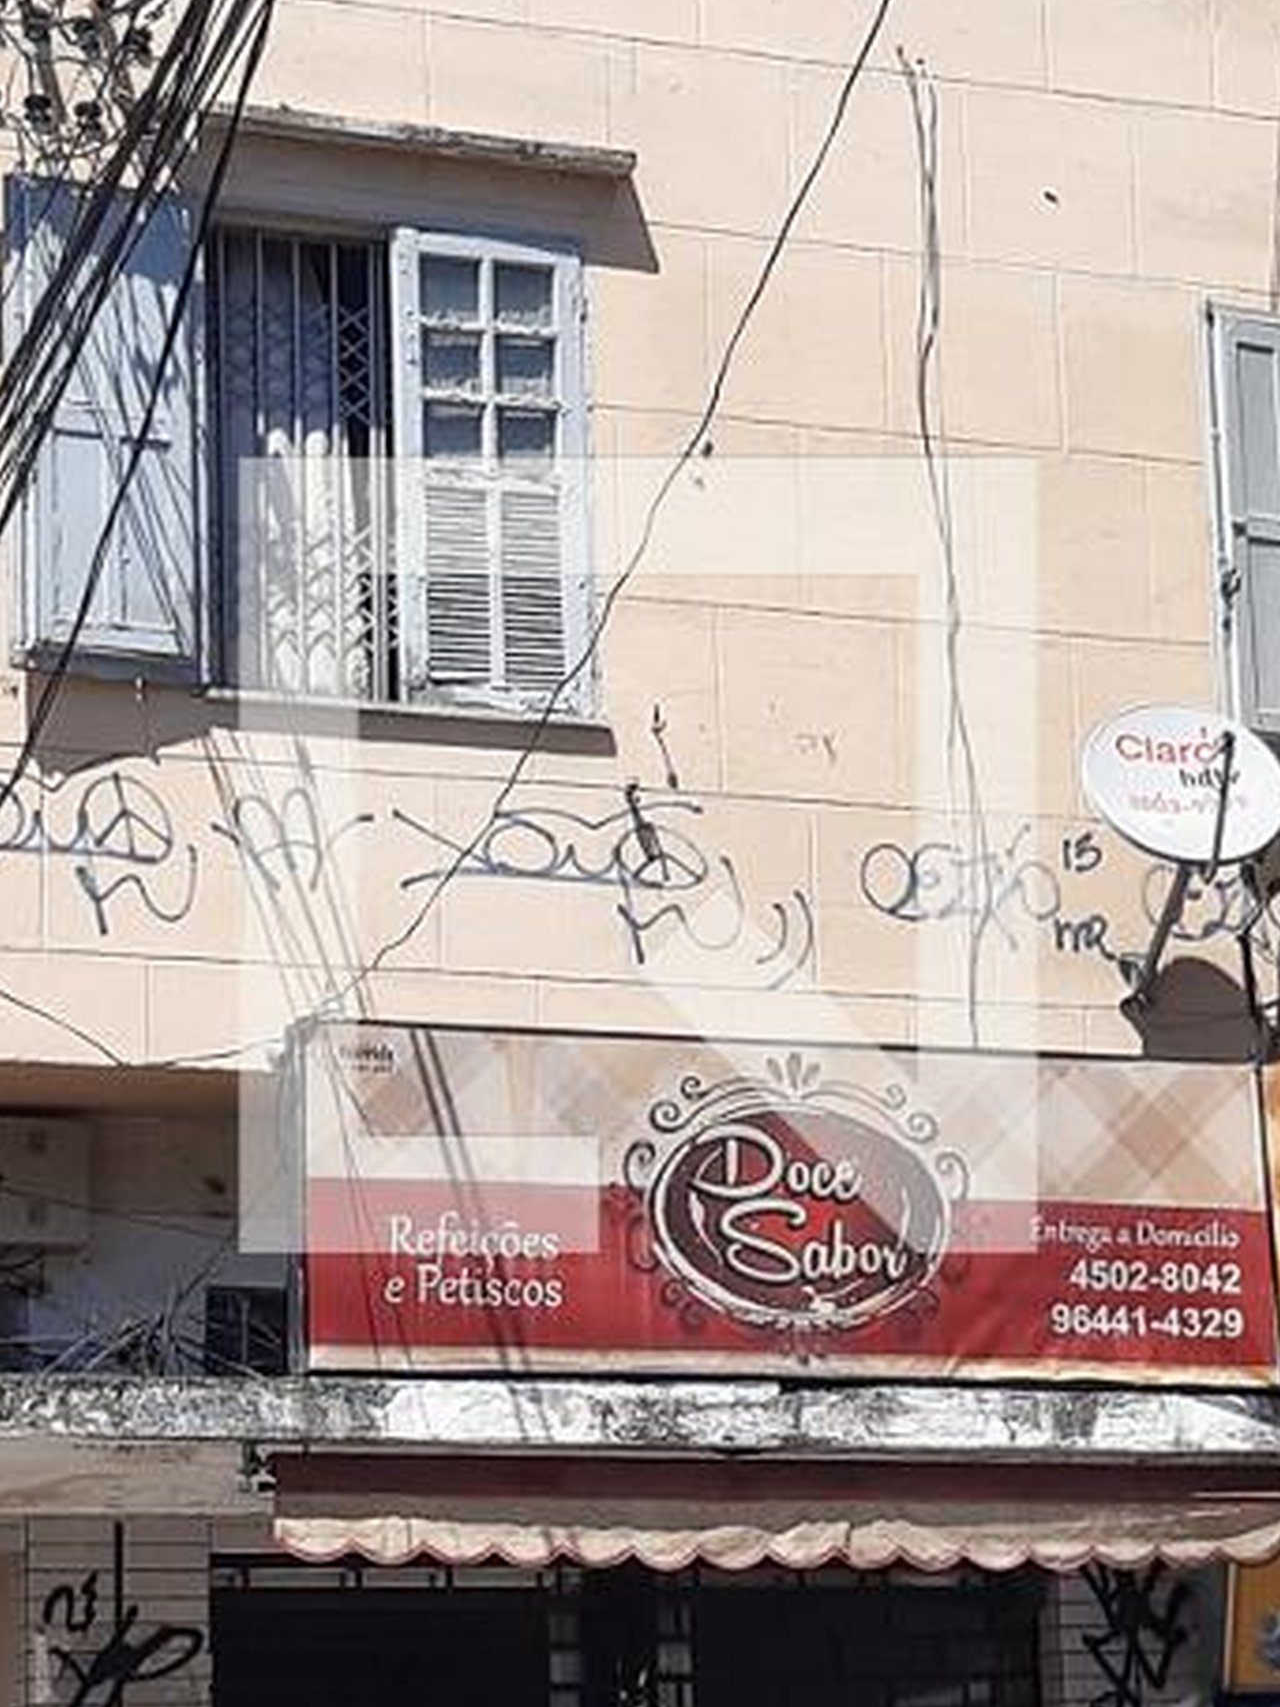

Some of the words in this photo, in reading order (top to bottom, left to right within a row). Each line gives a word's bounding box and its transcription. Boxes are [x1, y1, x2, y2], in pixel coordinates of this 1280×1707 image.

[691, 1122, 862, 1200] Doce
[389, 1210, 562, 1272] Refeições
[720, 1198, 908, 1282] Sabor
[1029, 1216, 1113, 1253] Entrega
[384, 1276, 406, 1304] e
[417, 1263, 563, 1307] Petiscos
[1070, 1260, 1242, 1294] 4502-8042
[1050, 1302, 1244, 1338] 96441-4329
